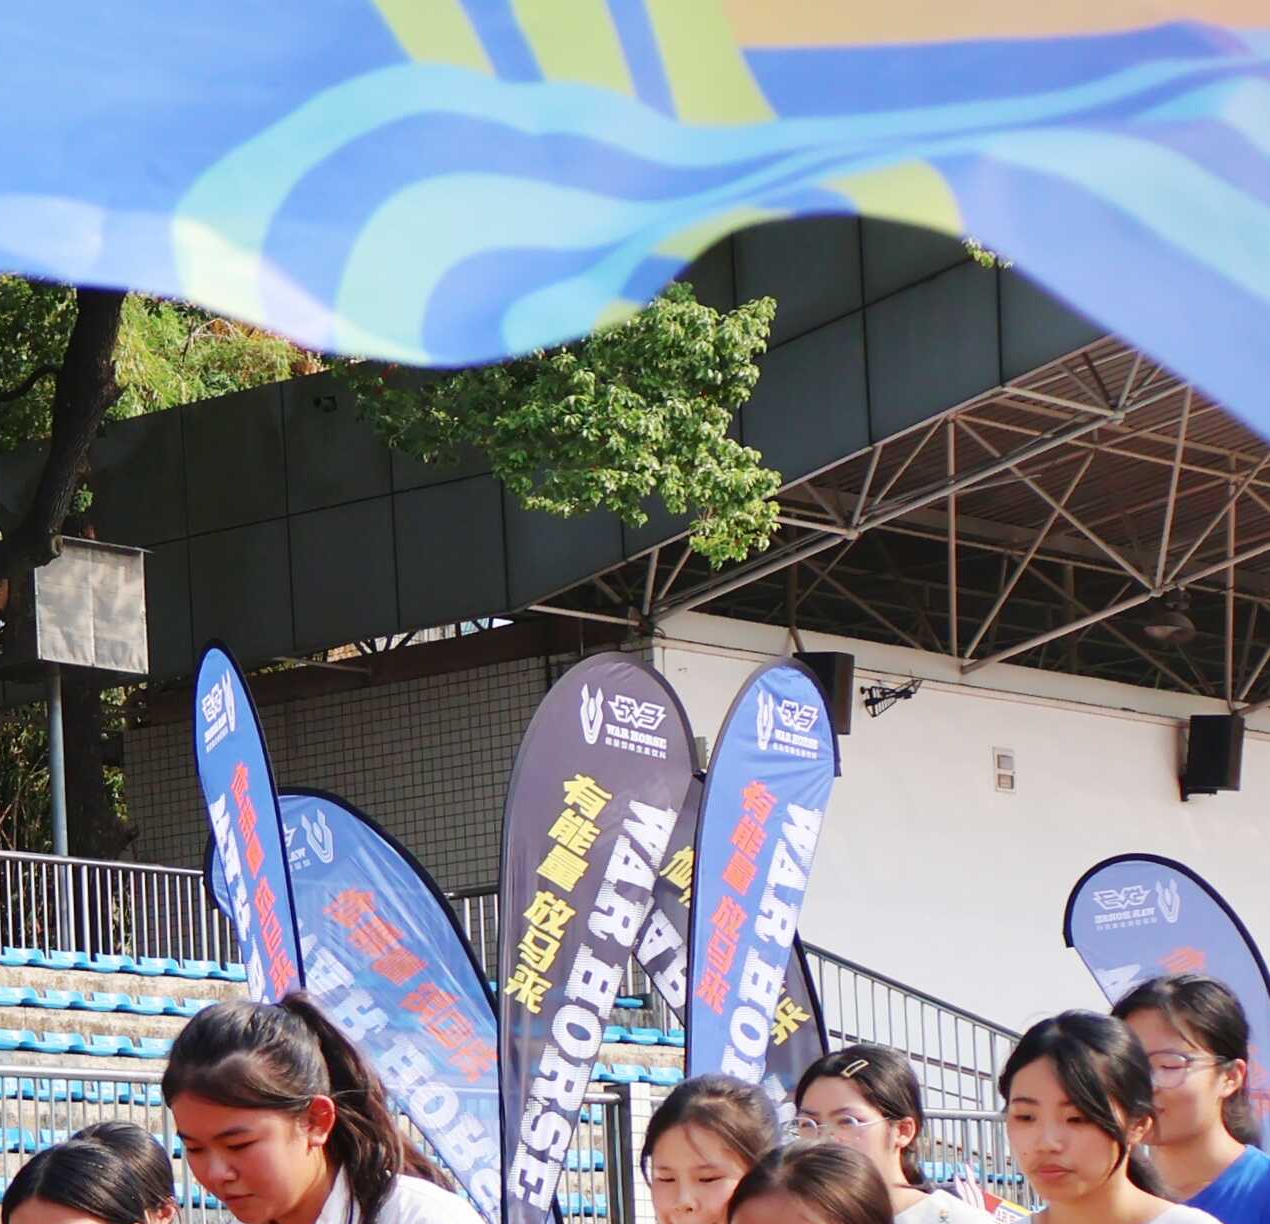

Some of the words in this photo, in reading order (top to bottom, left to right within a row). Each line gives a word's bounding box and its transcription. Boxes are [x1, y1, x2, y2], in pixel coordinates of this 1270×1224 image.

[606, 723, 630, 741] WAR
[630, 727, 667, 749] HORSE
[536, 774, 612, 892] 有能量
[587, 799, 668, 948] WAR
[723, 779, 778, 895] 有能量
[755, 802, 824, 949] WAR
[504, 890, 577, 1015] 放马来
[695, 895, 748, 1016] 放马来
[507, 942, 625, 1212] HORSE
